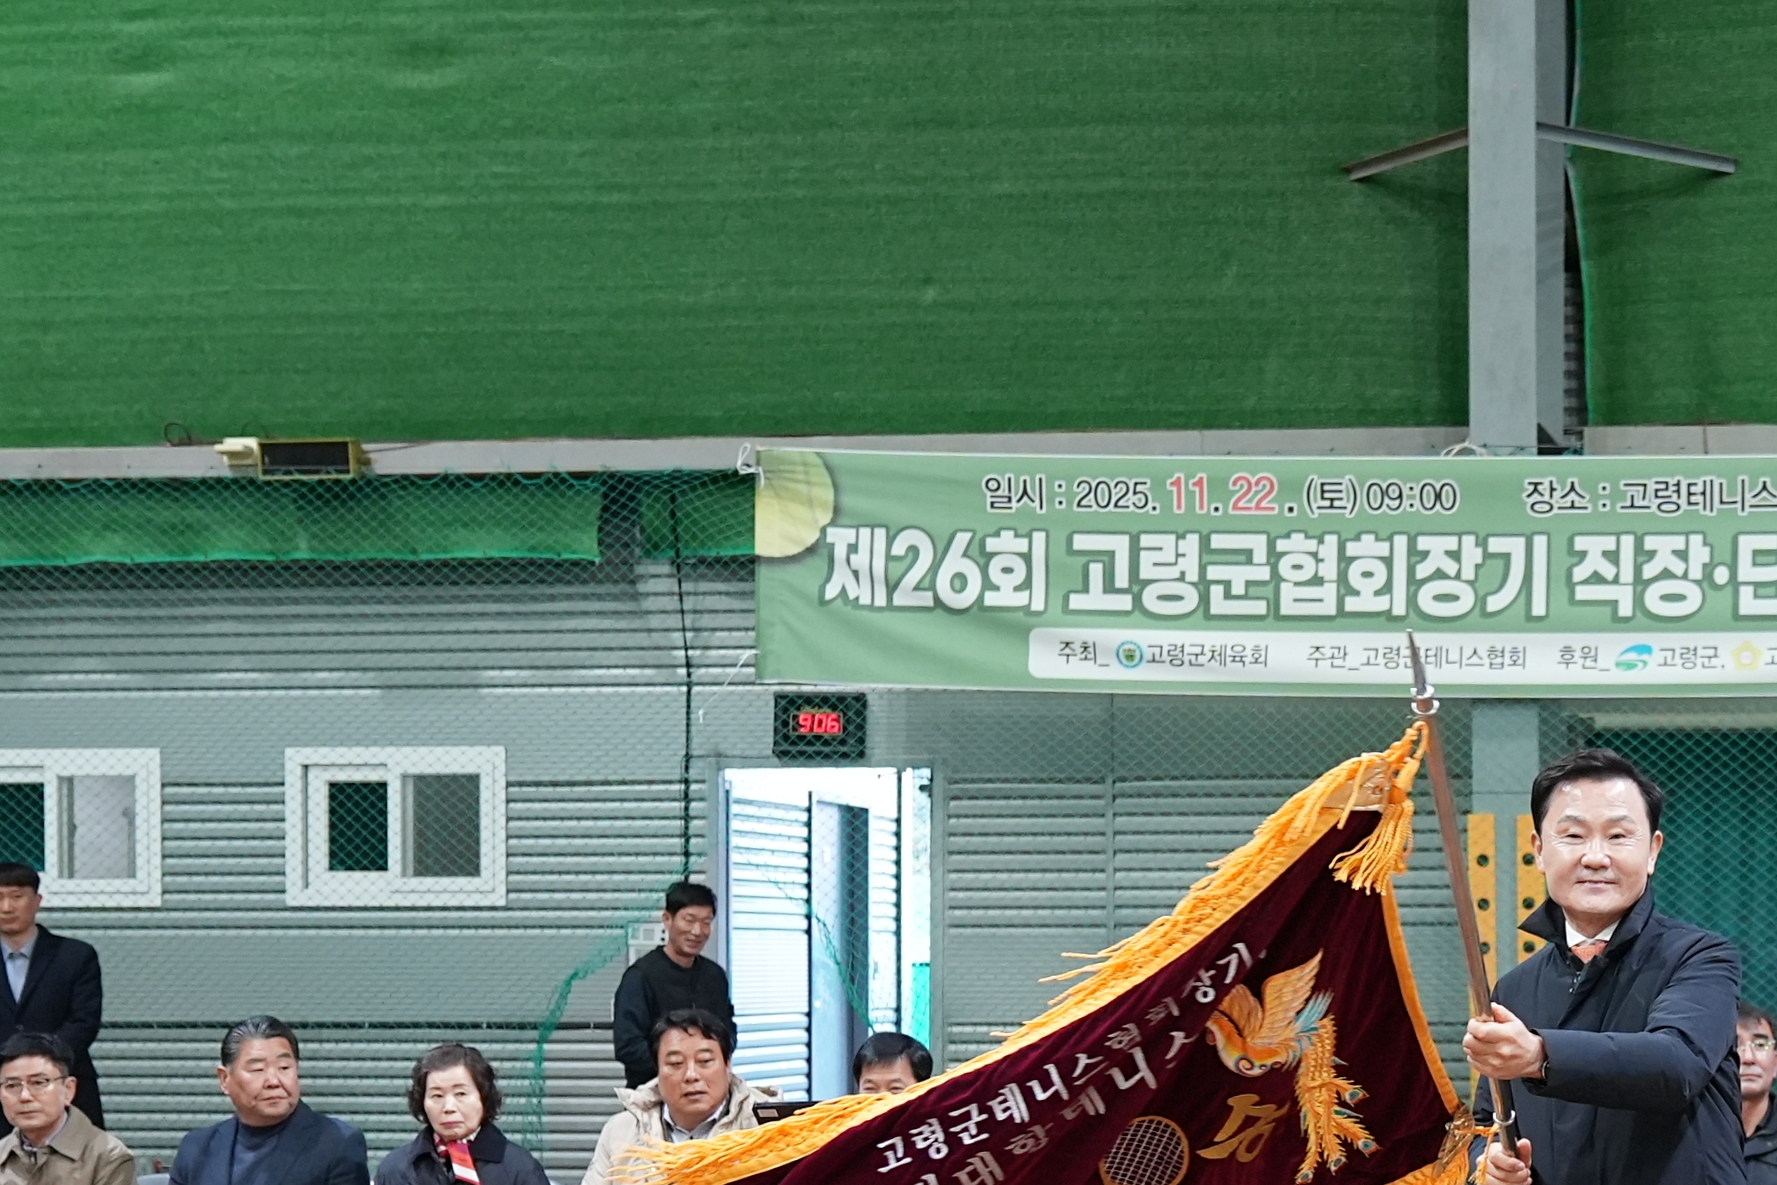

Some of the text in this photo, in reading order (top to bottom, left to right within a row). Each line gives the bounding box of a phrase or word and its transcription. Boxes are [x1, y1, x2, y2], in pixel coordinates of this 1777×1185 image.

[984, 476, 1045, 511] 일시
[1525, 479, 1589, 514] 장소
[824, 526, 1046, 613] 제26회
[1068, 530, 1549, 618] 고령군협회장기
[1146, 642, 1269, 668] 고령군체육회
